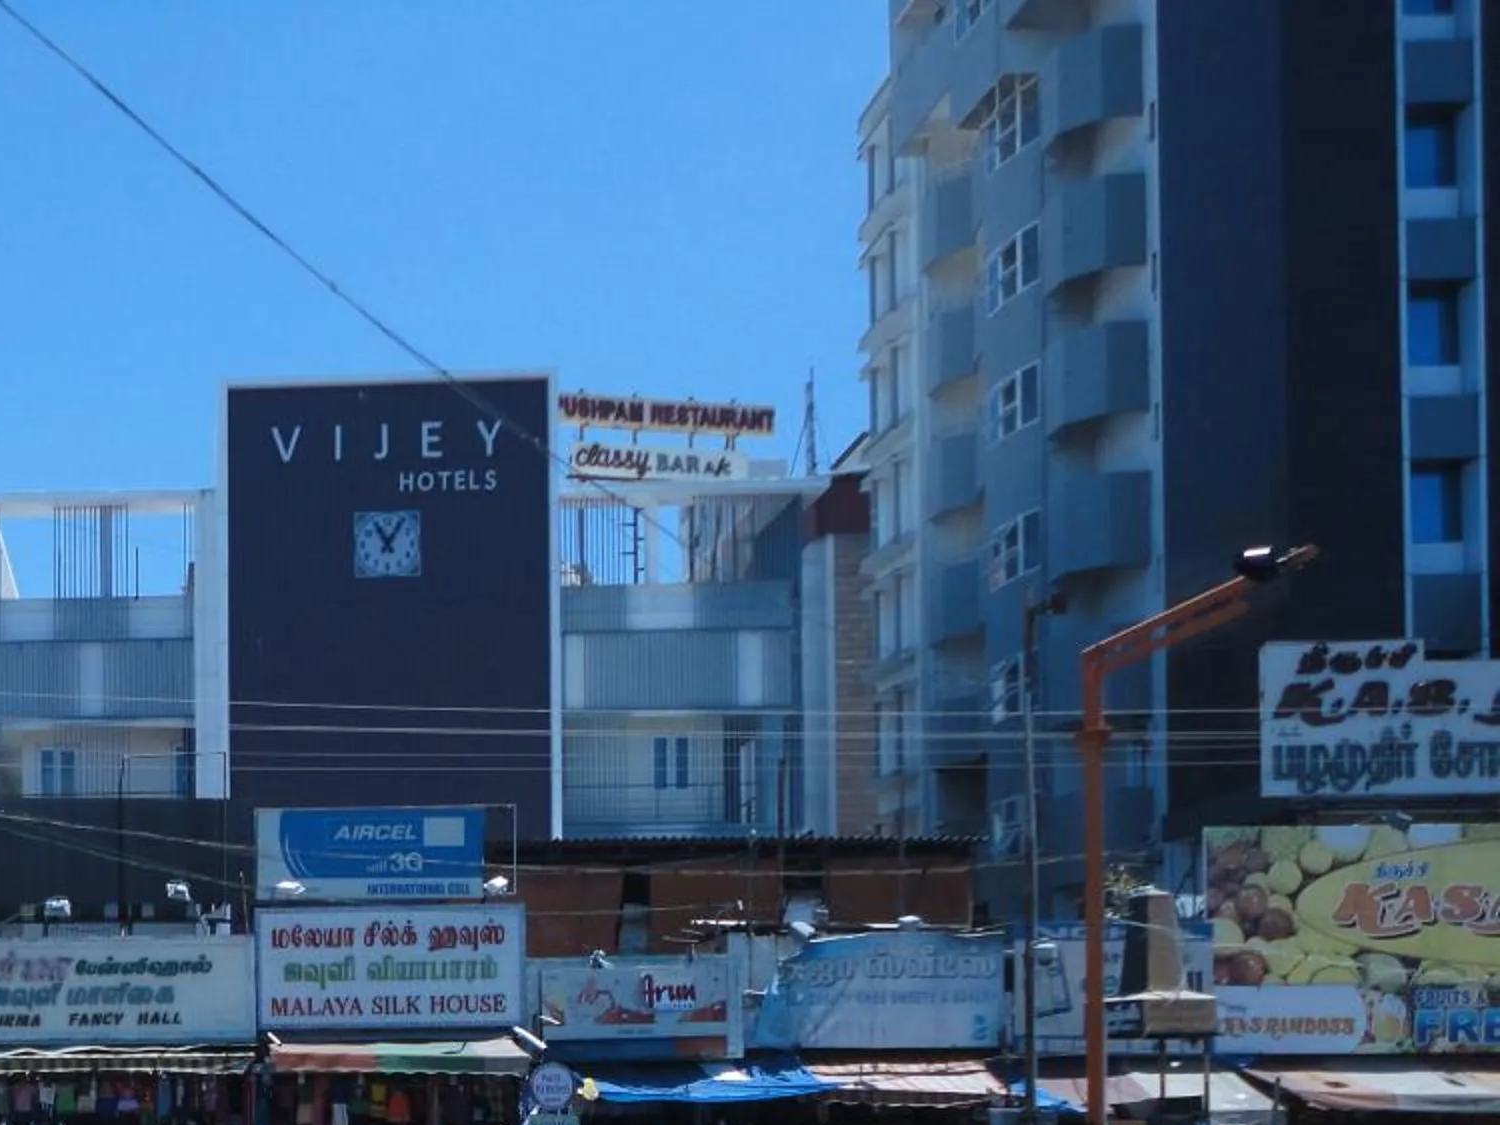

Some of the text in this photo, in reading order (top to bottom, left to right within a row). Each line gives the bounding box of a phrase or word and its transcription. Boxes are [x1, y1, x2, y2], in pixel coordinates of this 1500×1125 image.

[650, 402, 775, 431] RESTAURANT
[271, 420, 502, 463] VIJEY
[656, 453, 699, 474] BAR
[400, 470, 498, 492] HOTELS
[333, 824, 417, 840] AIRCEL
[389, 852, 423, 872] 3G
[271, 924, 355, 949] மலேயா
[642, 973, 697, 1009] Arun
[271, 994, 507, 1017] MALAYA SILK HOUSE
[68, 1013, 124, 1027] FANCY
[137, 1012, 183, 1026] HALL
